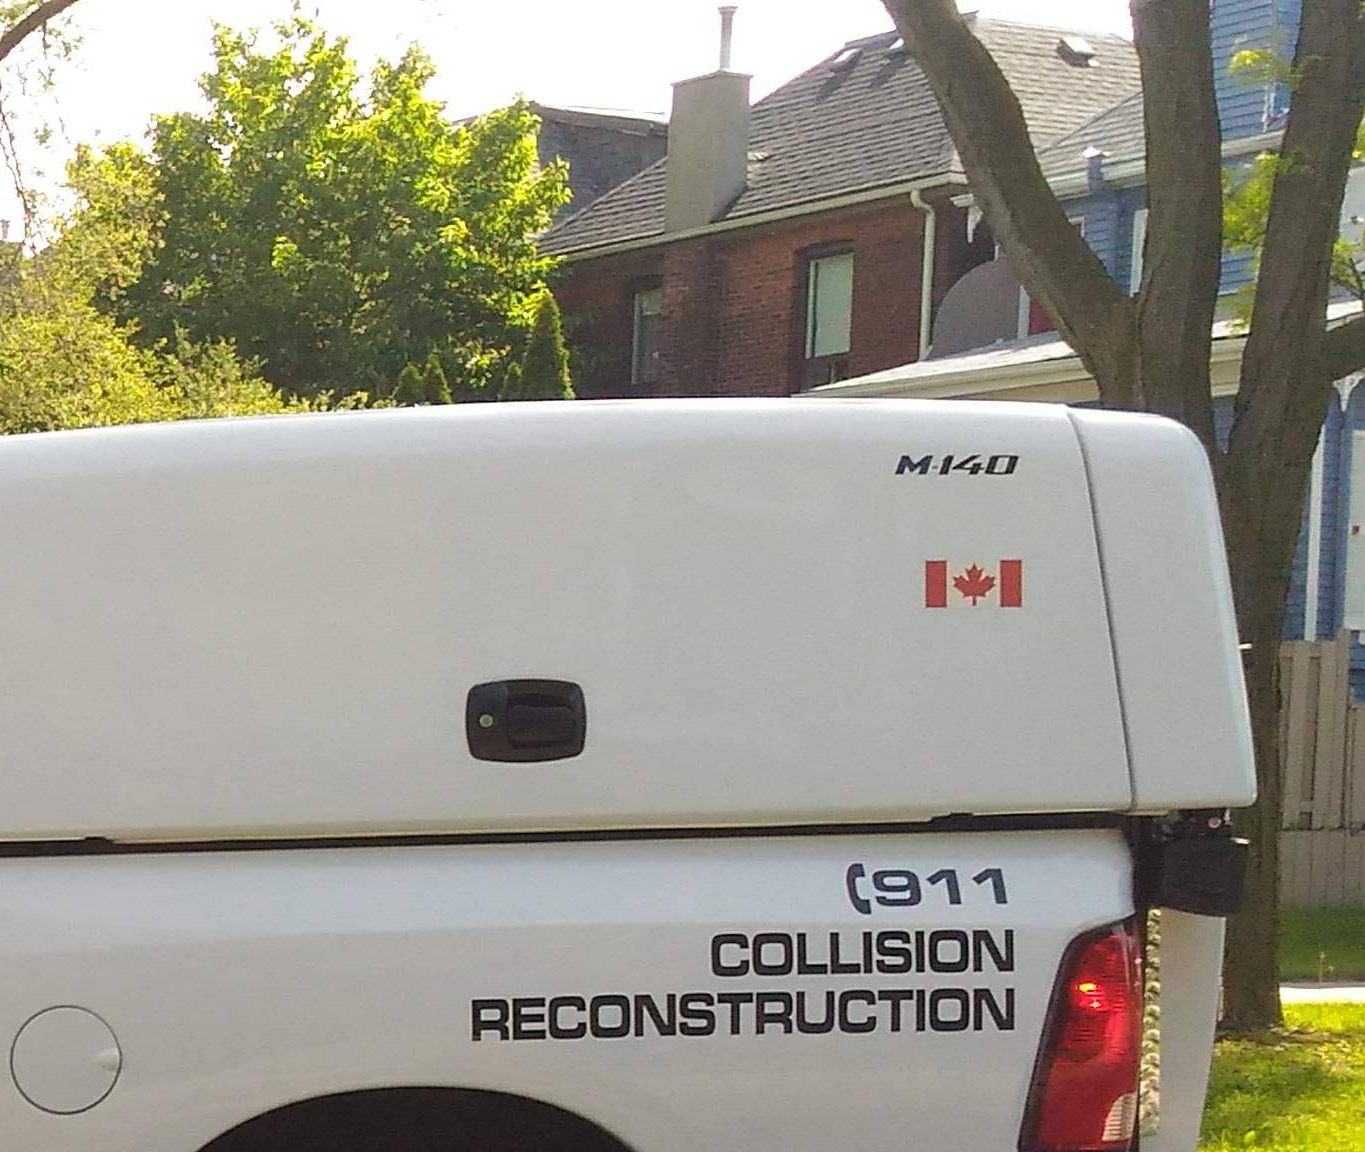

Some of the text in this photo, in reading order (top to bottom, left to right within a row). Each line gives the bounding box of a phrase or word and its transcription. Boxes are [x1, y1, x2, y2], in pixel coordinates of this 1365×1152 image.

[872, 868, 1007, 906] 911
[711, 930, 1014, 977] COLLISION
[472, 988, 1014, 1041] RECONSTRUCTION
